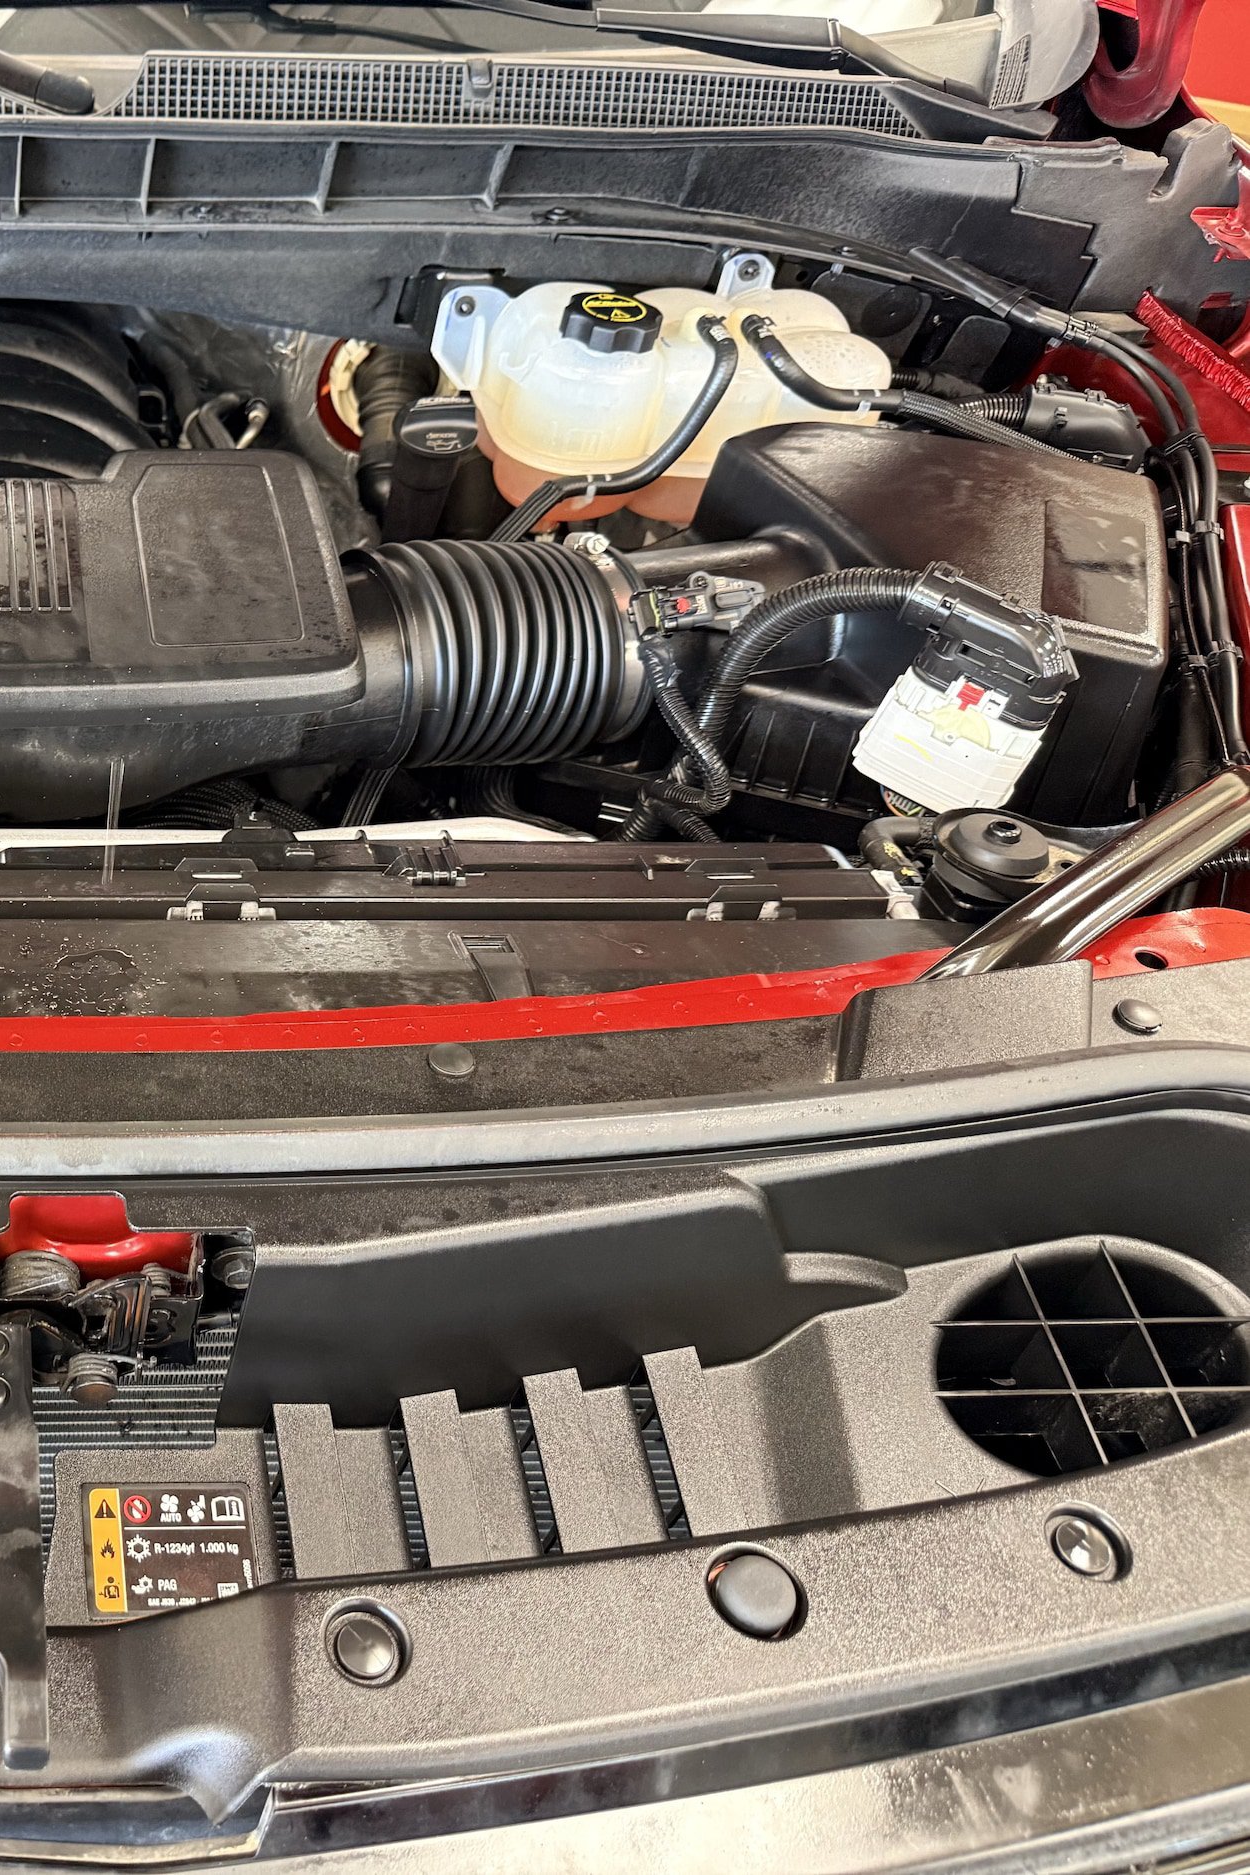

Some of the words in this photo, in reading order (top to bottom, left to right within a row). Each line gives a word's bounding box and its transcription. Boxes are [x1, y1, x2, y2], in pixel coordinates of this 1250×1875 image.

[160, 1512, 182, 1523] AUTO
[153, 1542, 196, 1556] R-1234yf
[199, 1542, 226, 1553] 1.000
[226, 1542, 239, 1555] kg
[157, 1578, 178, 1591] PAG
